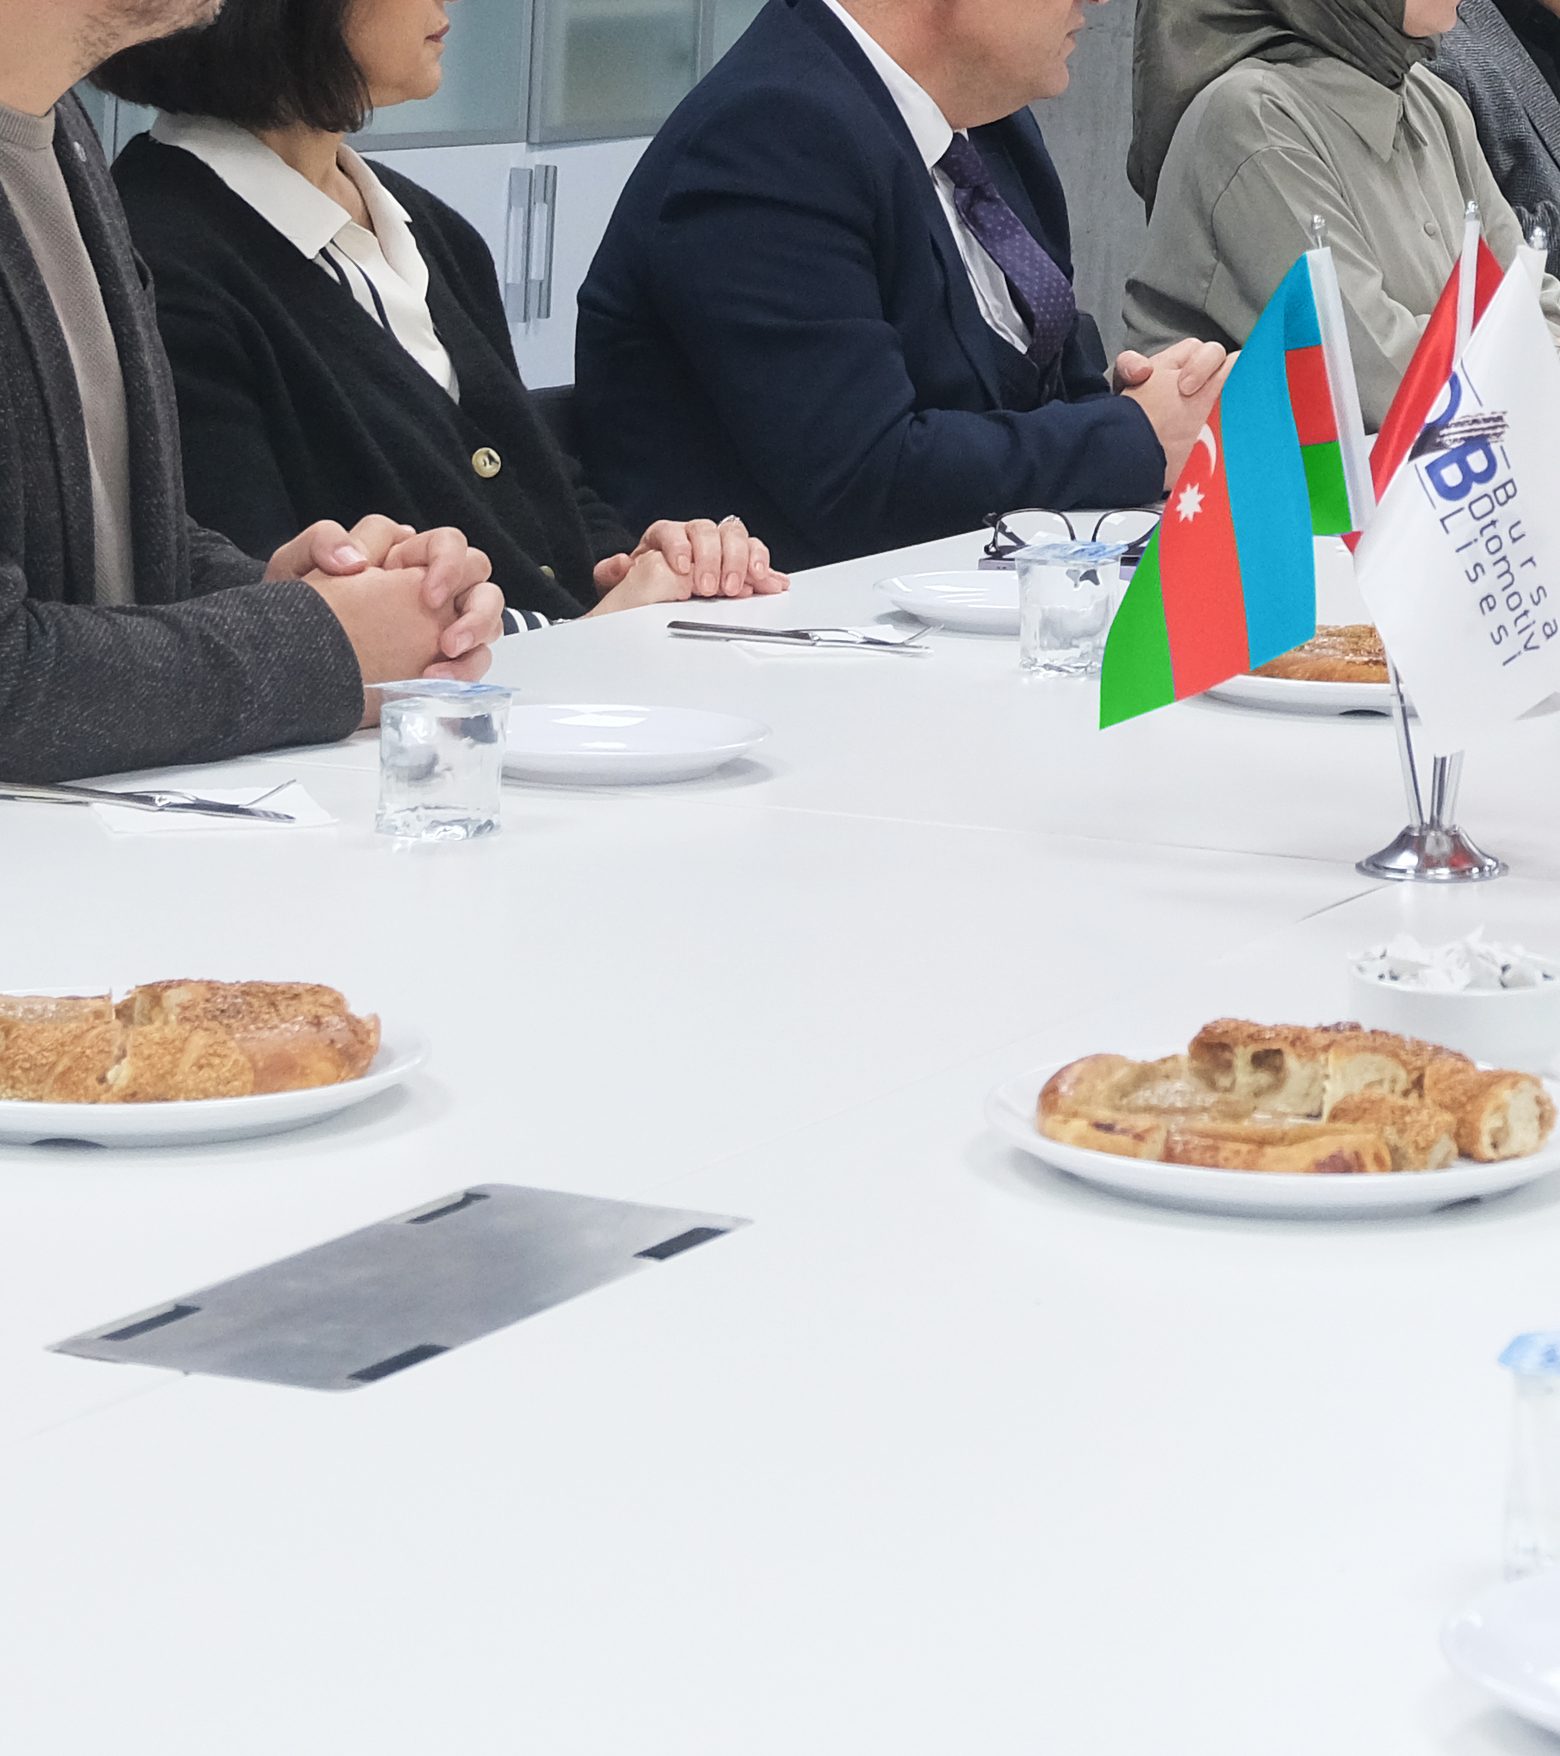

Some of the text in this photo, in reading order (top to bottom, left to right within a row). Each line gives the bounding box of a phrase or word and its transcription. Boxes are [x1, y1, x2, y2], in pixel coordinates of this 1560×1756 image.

[1439, 507, 1522, 666] Lisesi
[1468, 493, 1540, 652] Otomotiv
[1492, 478, 1559, 641] Bursa
